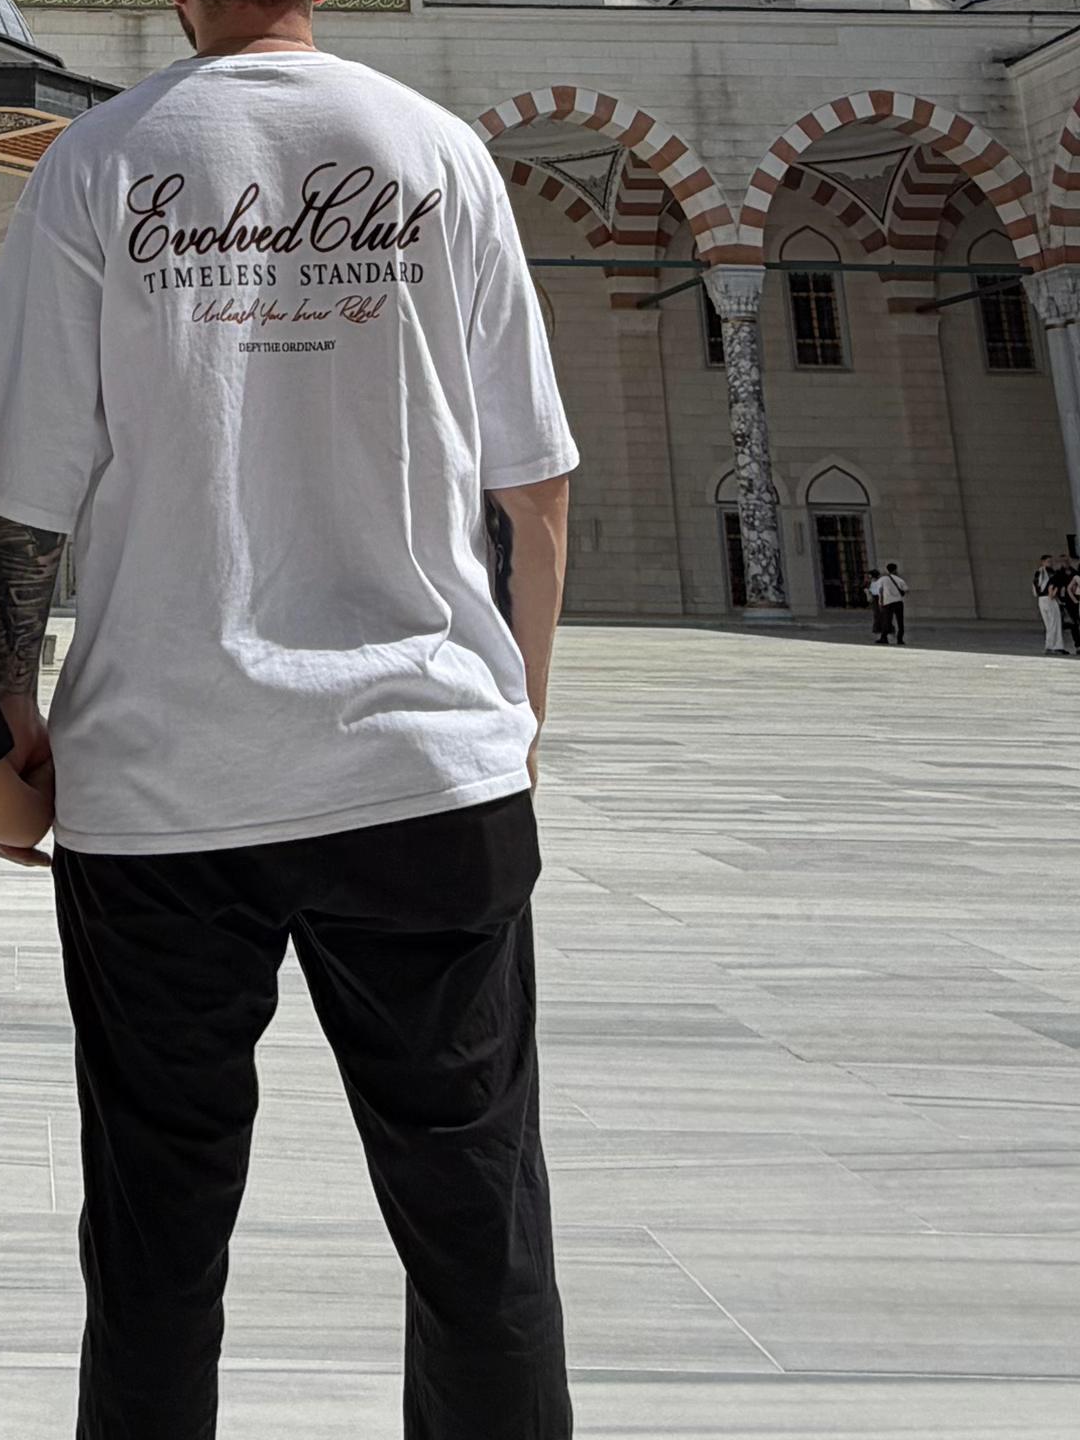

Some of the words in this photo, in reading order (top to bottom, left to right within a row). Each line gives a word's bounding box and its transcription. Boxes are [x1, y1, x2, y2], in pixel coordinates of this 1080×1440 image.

[127, 173, 319, 263] Evolved
[302, 162, 442, 252] Club
[144, 264, 277, 294] TIMELESS
[300, 262, 424, 287] STANDARD
[192, 298, 260, 325] Unleash
[292, 298, 333, 322] Inner
[335, 294, 387, 324] Rebel
[238, 342, 263, 353] DEFY
[263, 342, 281, 353] THE
[282, 340, 336, 353] ORDINARY
